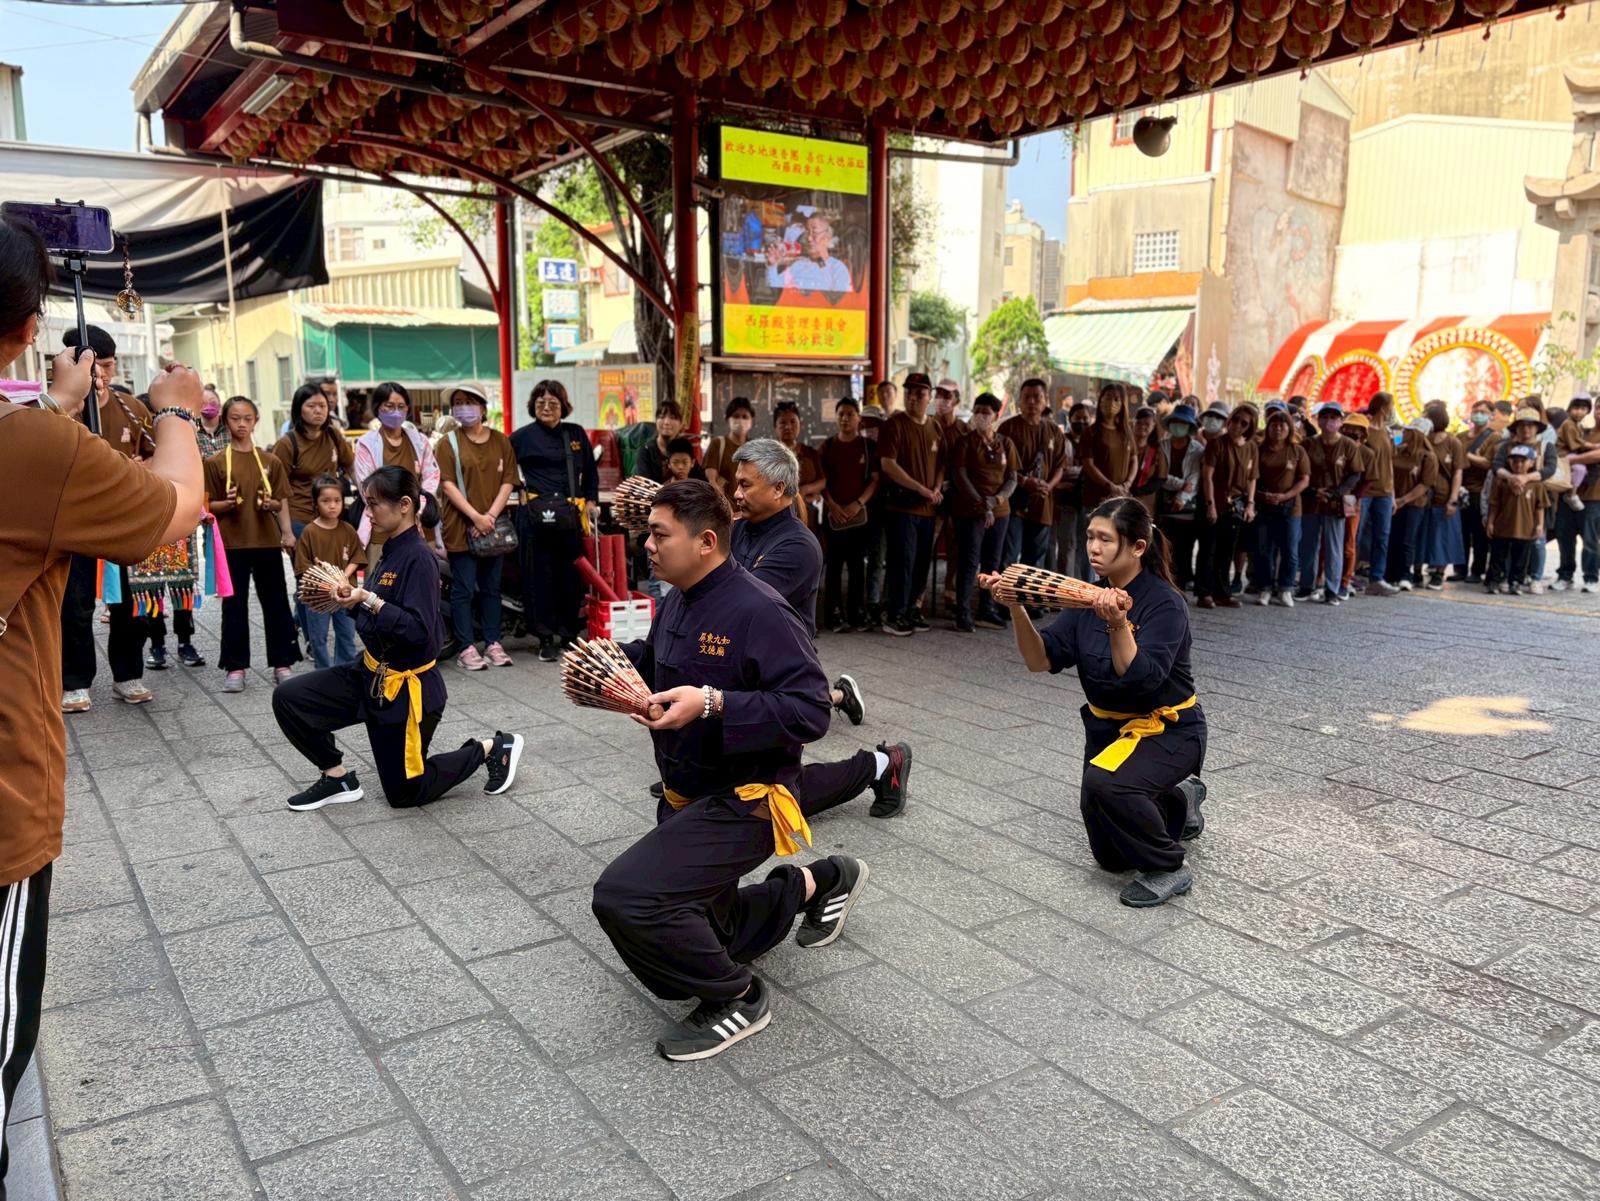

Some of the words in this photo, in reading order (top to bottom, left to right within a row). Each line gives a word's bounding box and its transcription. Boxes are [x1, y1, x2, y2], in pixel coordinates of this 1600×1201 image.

[745, 314, 847, 332] 西羅殿管理委員會
[760, 331, 835, 347] 十二萬分歡迎
